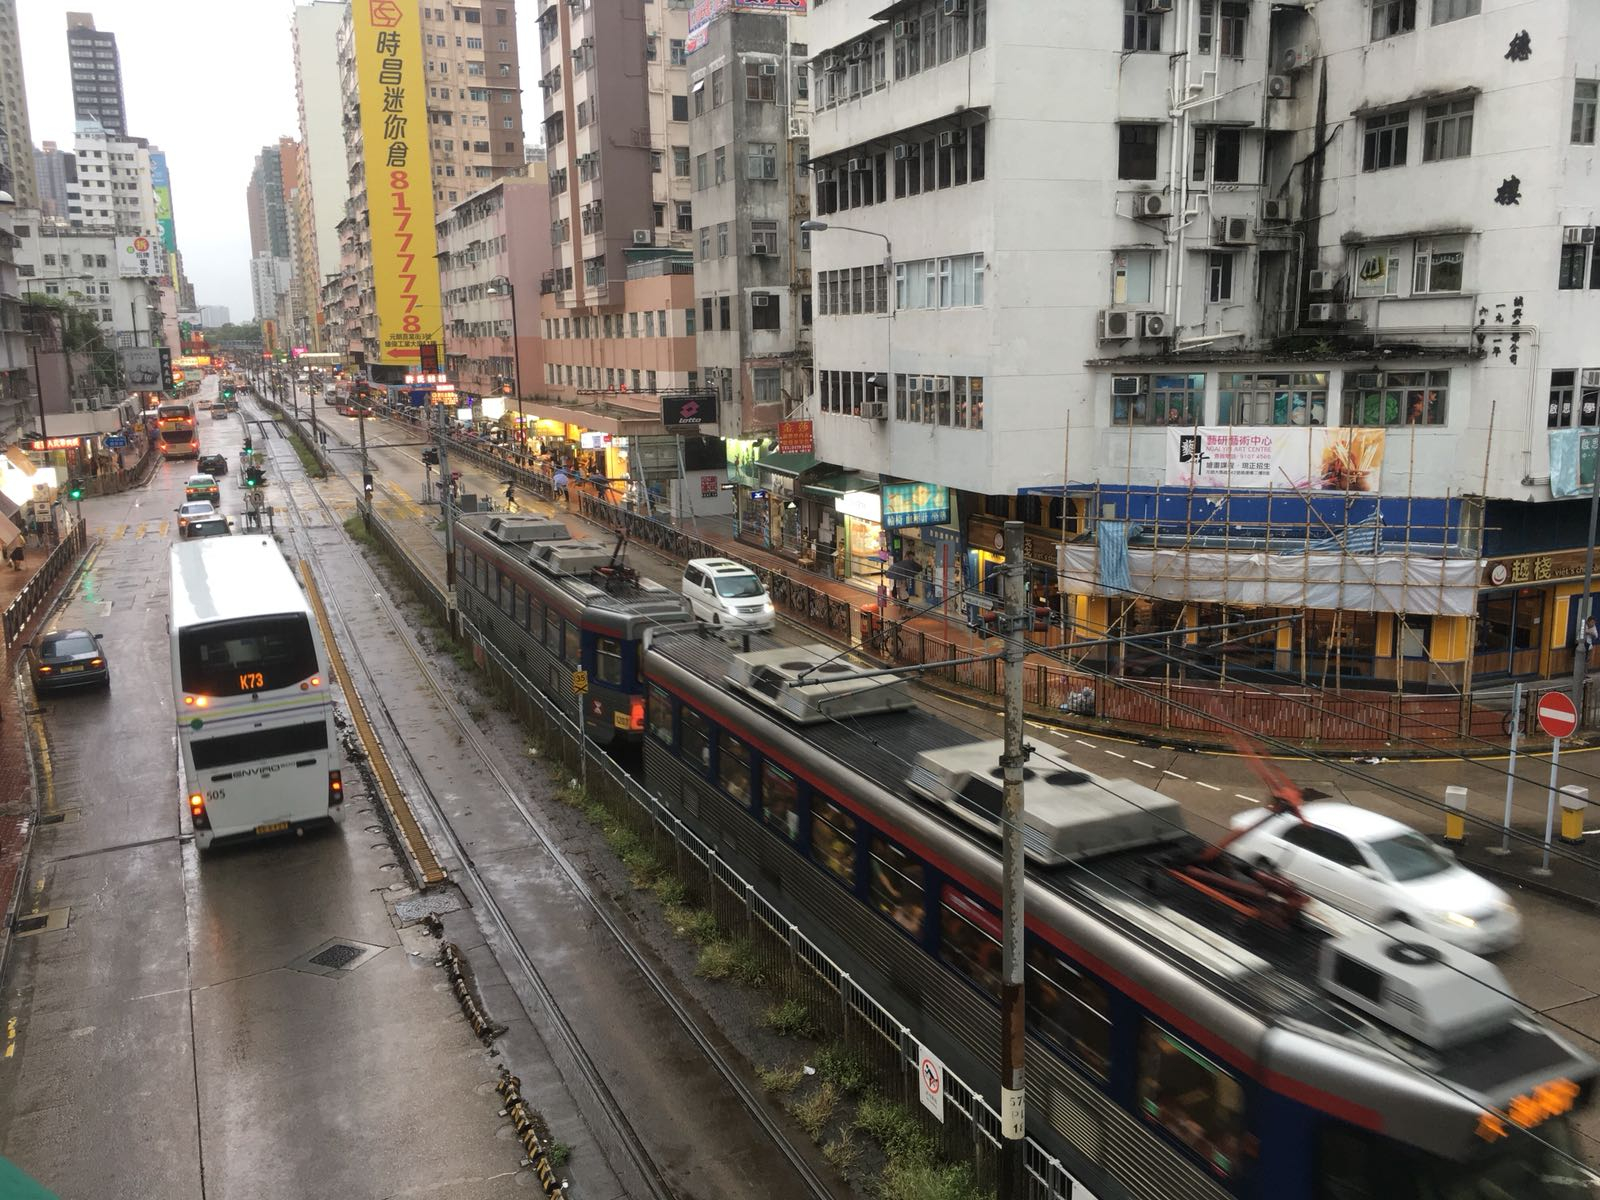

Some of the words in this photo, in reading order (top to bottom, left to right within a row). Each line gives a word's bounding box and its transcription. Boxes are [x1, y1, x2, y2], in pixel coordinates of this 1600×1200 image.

[376, 31, 410, 168] 時昌迷你倉
[390, 170, 422, 333] 81777778
[1512, 556, 1552, 582] 越棧
[239, 672, 264, 690] K73
